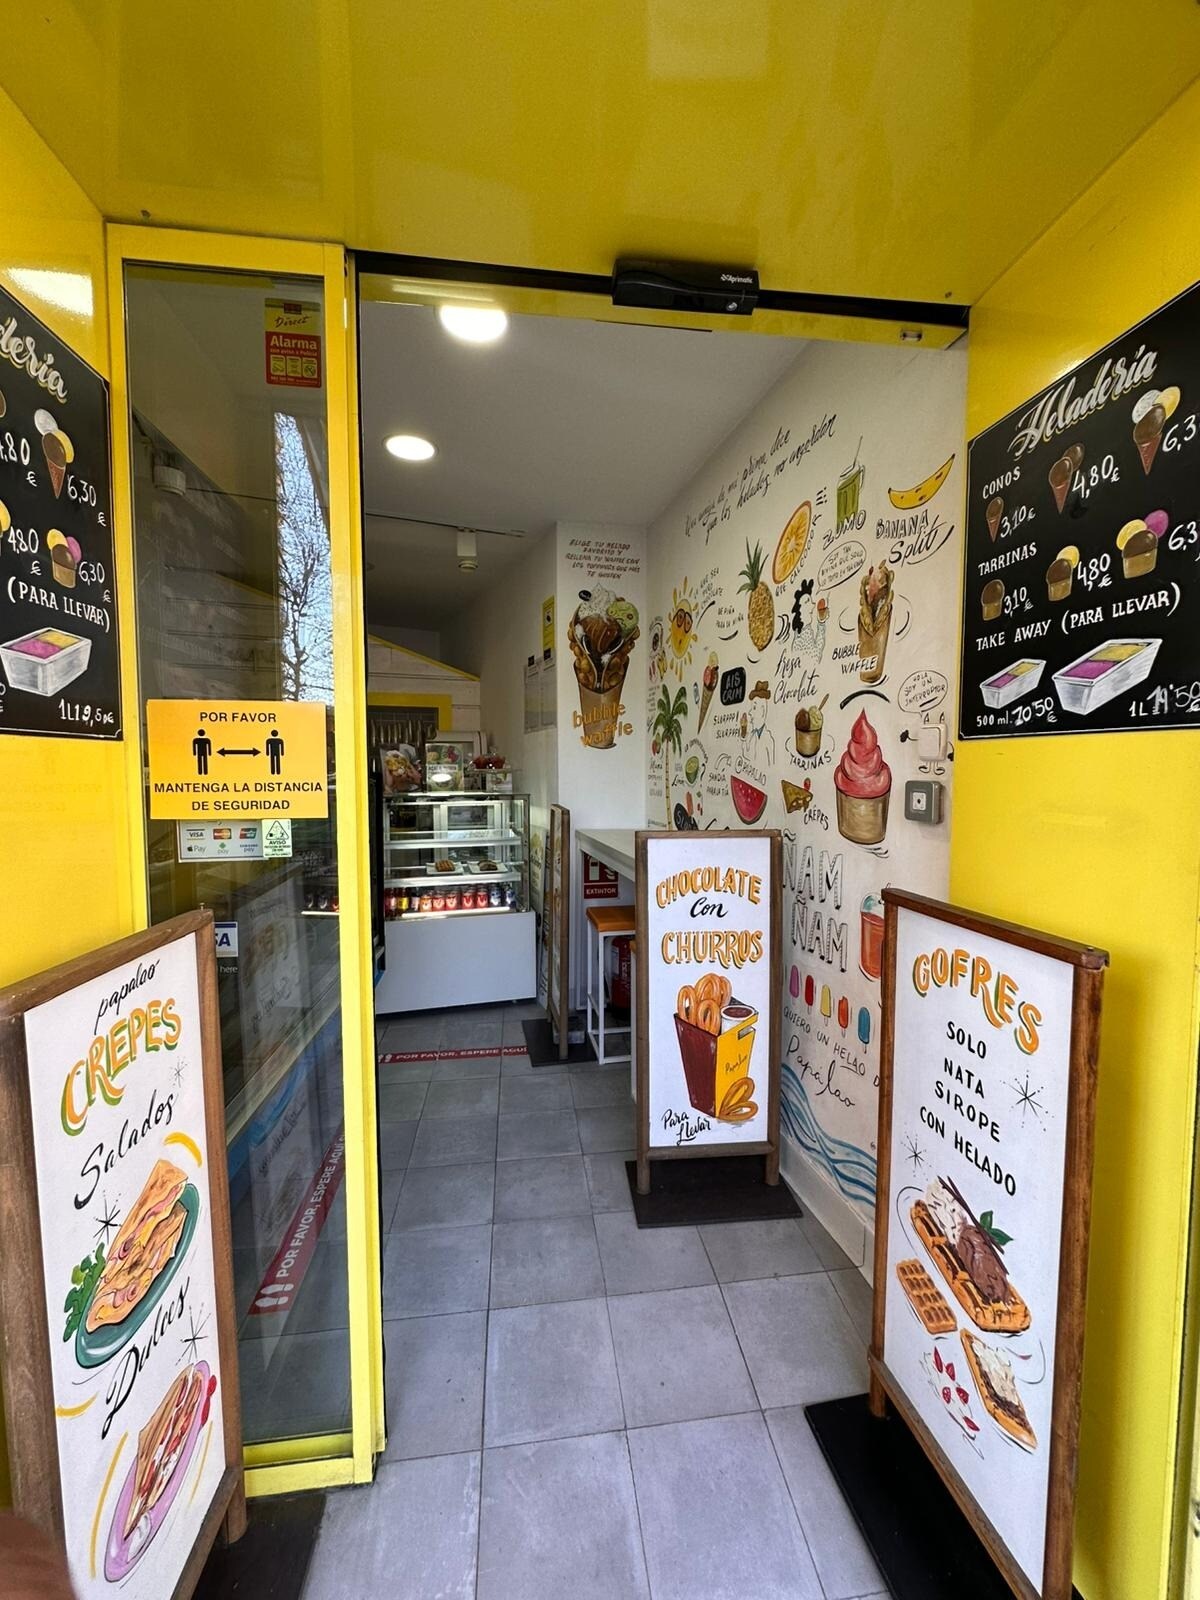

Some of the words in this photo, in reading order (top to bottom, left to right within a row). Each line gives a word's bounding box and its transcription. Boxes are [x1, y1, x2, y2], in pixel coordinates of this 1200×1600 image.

[270, 335, 317, 350] Alarma
[1007, 345, 1158, 461] Heladería
[1162, 414, 1200, 453] 6,3
[67, 475, 97, 507] 6,30
[982, 466, 1021, 499] CONOS
[8, 526, 39, 555] 4,80
[823, 510, 867, 550] ZUMO
[876, 509, 929, 540] BANANA
[889, 514, 948, 568] Split
[1168, 521, 1200, 551] 6,3
[78, 561, 105, 586] 6,30
[978, 542, 1038, 575] TARRINAS
[8, 576, 59, 611] (PARA
[63, 596, 110, 633] LLEVAR)
[976, 632, 1005, 651] TAKE
[1014, 619, 1052, 643] AWAY
[1061, 606, 1104, 635] (PARA
[1112, 582, 1181, 618] LLEVAR)
[831, 643, 860, 661] BUBBLE
[841, 656, 877, 674] WAFFLE
[725, 671, 741, 689] AIS
[774, 668, 820, 704] Chocolate
[200, 712, 228, 723] POR
[231, 712, 277, 723] FAVOR
[572, 702, 626, 729] bubble
[976, 714, 995, 727] 500
[580, 721, 634, 748] waffle
[789, 750, 832, 771] TARRINAS
[154, 782, 230, 793] MANTENGA
[233, 782, 250, 793] LA
[254, 782, 323, 792] DISTANCIA
[192, 801, 209, 811] DE
[213, 800, 290, 811] SEGURIDAD
[656, 866, 762, 909] CHOCOLATE
[690, 896, 729, 918] Con
[661, 930, 764, 970] CHURROS
[912, 948, 1043, 1056] GOFRES
[783, 1006, 811, 1034] QUIERO
[816, 1031, 829, 1046] UN
[833, 1043, 866, 1076] HELAO
[946, 1020, 987, 1059] SOLO
[60, 998, 183, 1137] CREPES
[943, 1057, 985, 1099] NATA
[661, 1108, 689, 1130] Para
[934, 1080, 1001, 1143] SIROPE
[676, 1118, 711, 1146] Llevar
[74, 1088, 178, 1211] Salados
[919, 1106, 946, 1139] CON
[954, 1130, 1017, 1197] HELADO
[276, 1249, 300, 1278] POR
[290, 1204, 321, 1247] FAVOR,
[310, 1164, 336, 1203] ESPERE
[101, 1275, 191, 1441] Dulces
